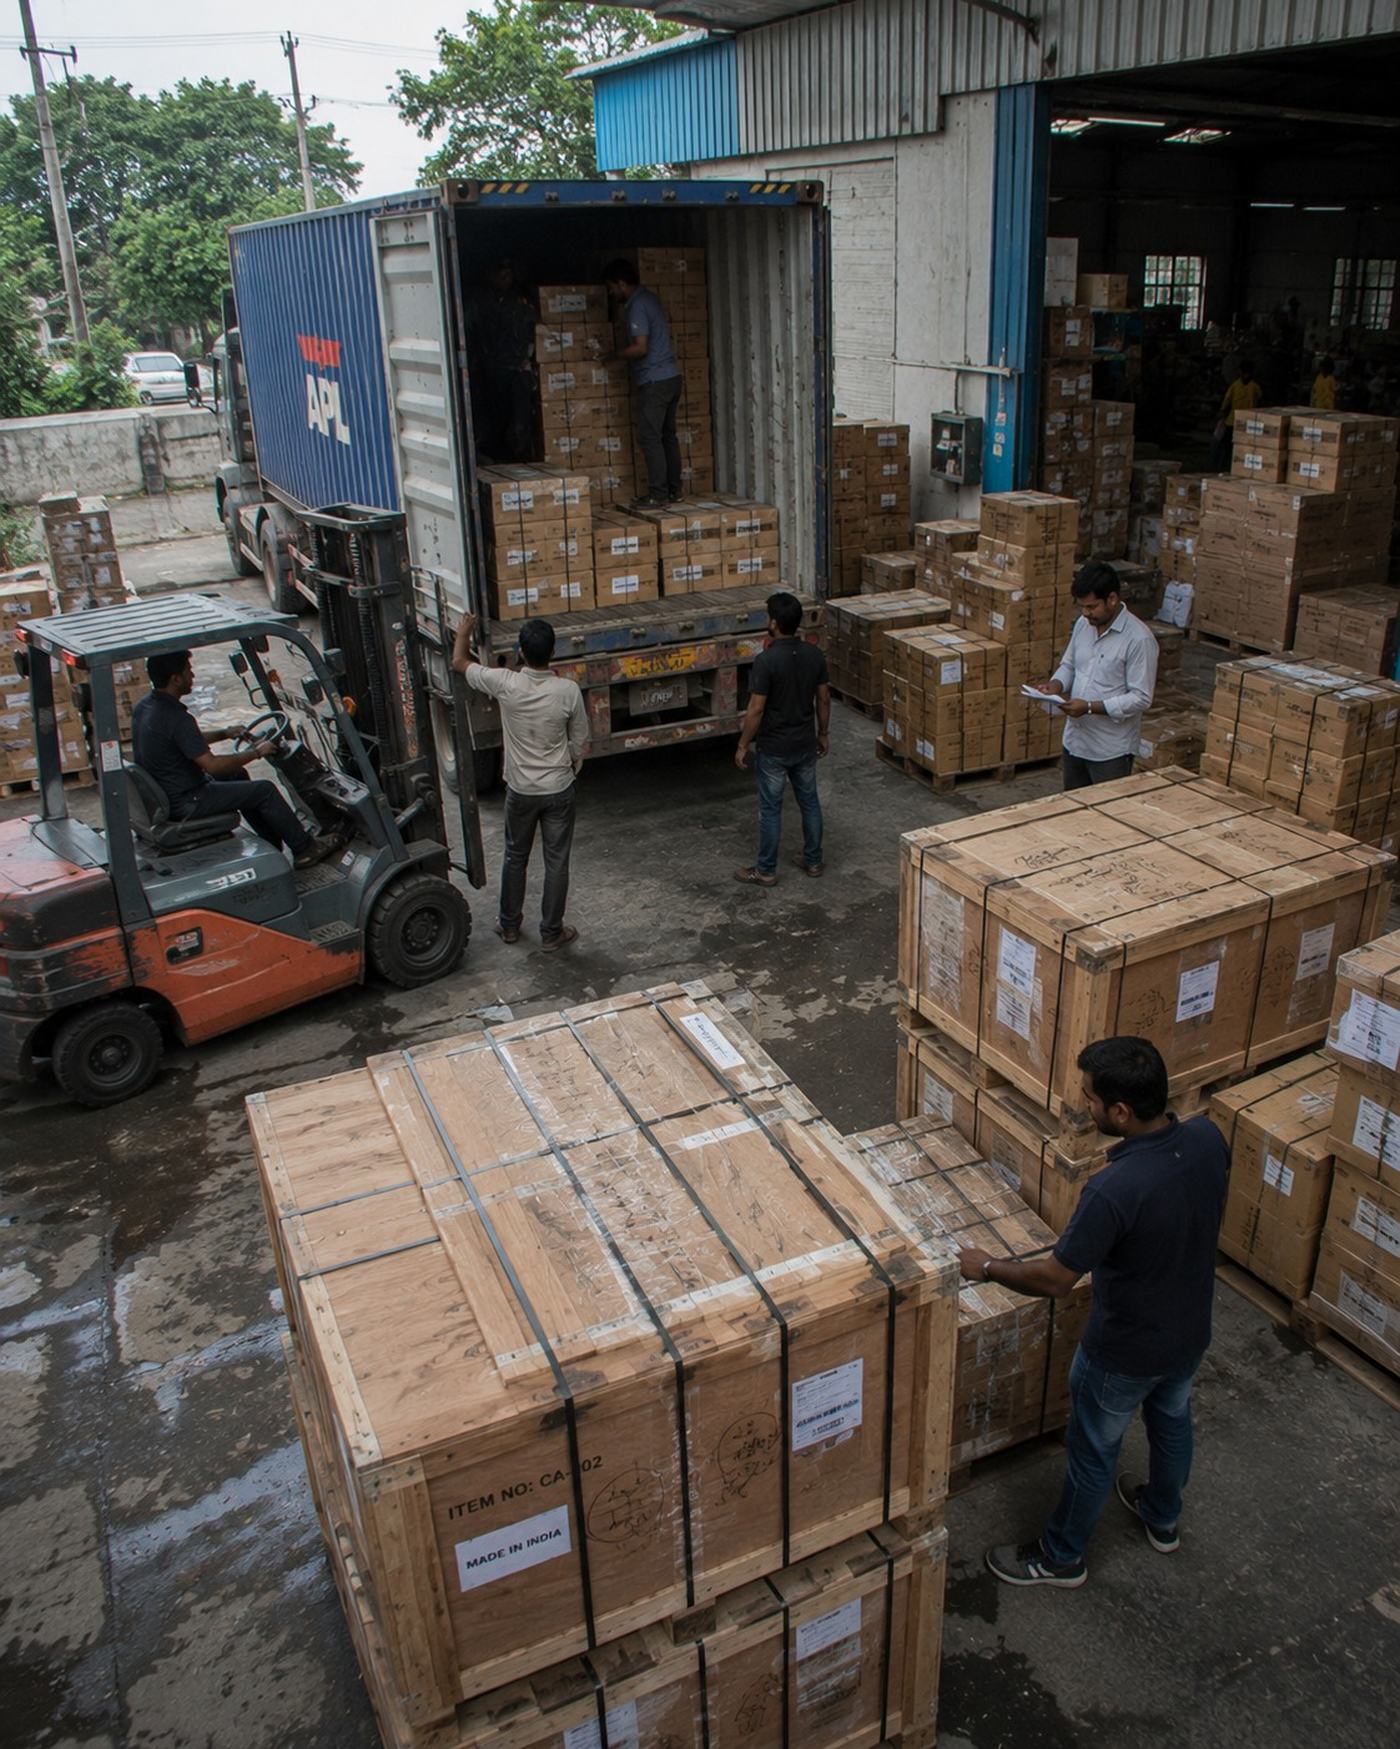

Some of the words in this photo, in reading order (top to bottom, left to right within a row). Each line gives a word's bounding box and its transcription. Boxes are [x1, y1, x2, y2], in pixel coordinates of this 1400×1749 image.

[306, 374, 350, 445] APL
[449, 1493, 495, 1520] ITEM
[501, 1481, 533, 1501] NO:
[540, 1455, 603, 1487] CA-02
[466, 1548, 506, 1569] MADE
[509, 1541, 523, 1554] IN
[527, 1528, 562, 1548] INDIA
